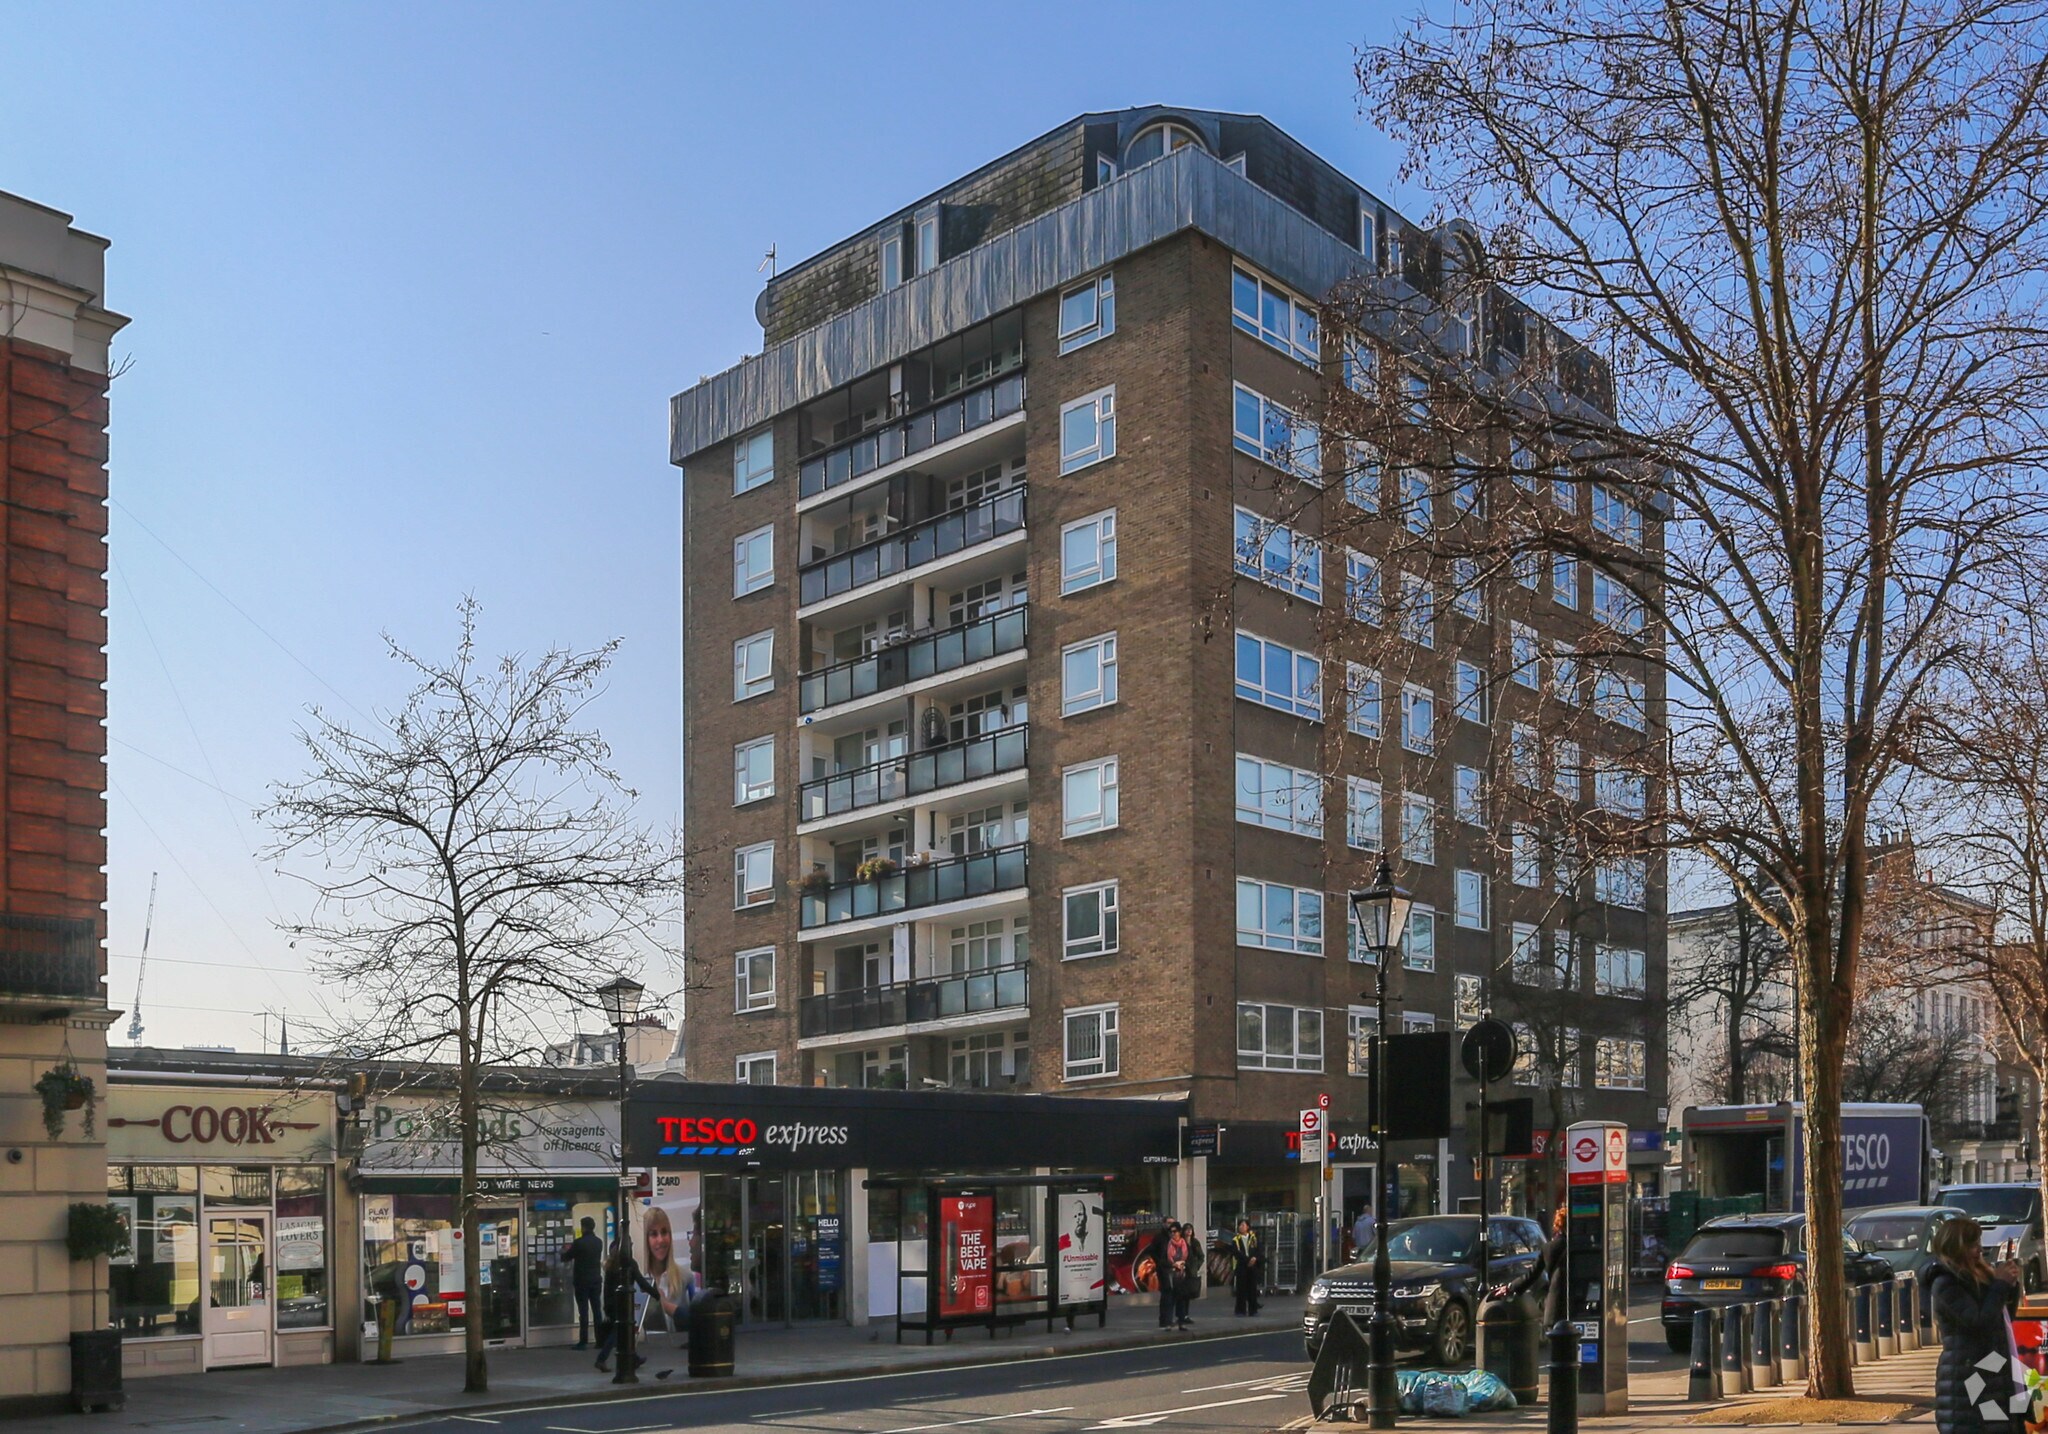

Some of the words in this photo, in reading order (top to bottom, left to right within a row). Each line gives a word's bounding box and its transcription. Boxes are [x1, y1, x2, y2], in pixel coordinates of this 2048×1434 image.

[1320, 1095, 1329, 1106] G
[161, 1105, 276, 1144] COOK
[538, 1125, 606, 1139] newsagents
[656, 1117, 758, 1144] TESCO
[765, 1121, 849, 1152] express
[543, 1139, 561, 1152] off
[561, 1138, 602, 1152] licence
[1340, 1132, 1379, 1156] expre
[1840, 1133, 1890, 1171] ESCO
[476, 1180, 489, 1189] OD
[496, 1180, 520, 1189] WINE
[528, 1180, 554, 1189] NEWS
[368, 1207, 389, 1216] PLAY
[818, 1218, 839, 1227] HELLO
[280, 1230, 320, 1242] LOVERS
[960, 1233, 981, 1245] THE
[1107, 1233, 1126, 1244] CHOICE
[960, 1245, 987, 1258] BEST
[1063, 1253, 1099, 1263] #Unmissable
[961, 1258, 987, 1271] VAPE
